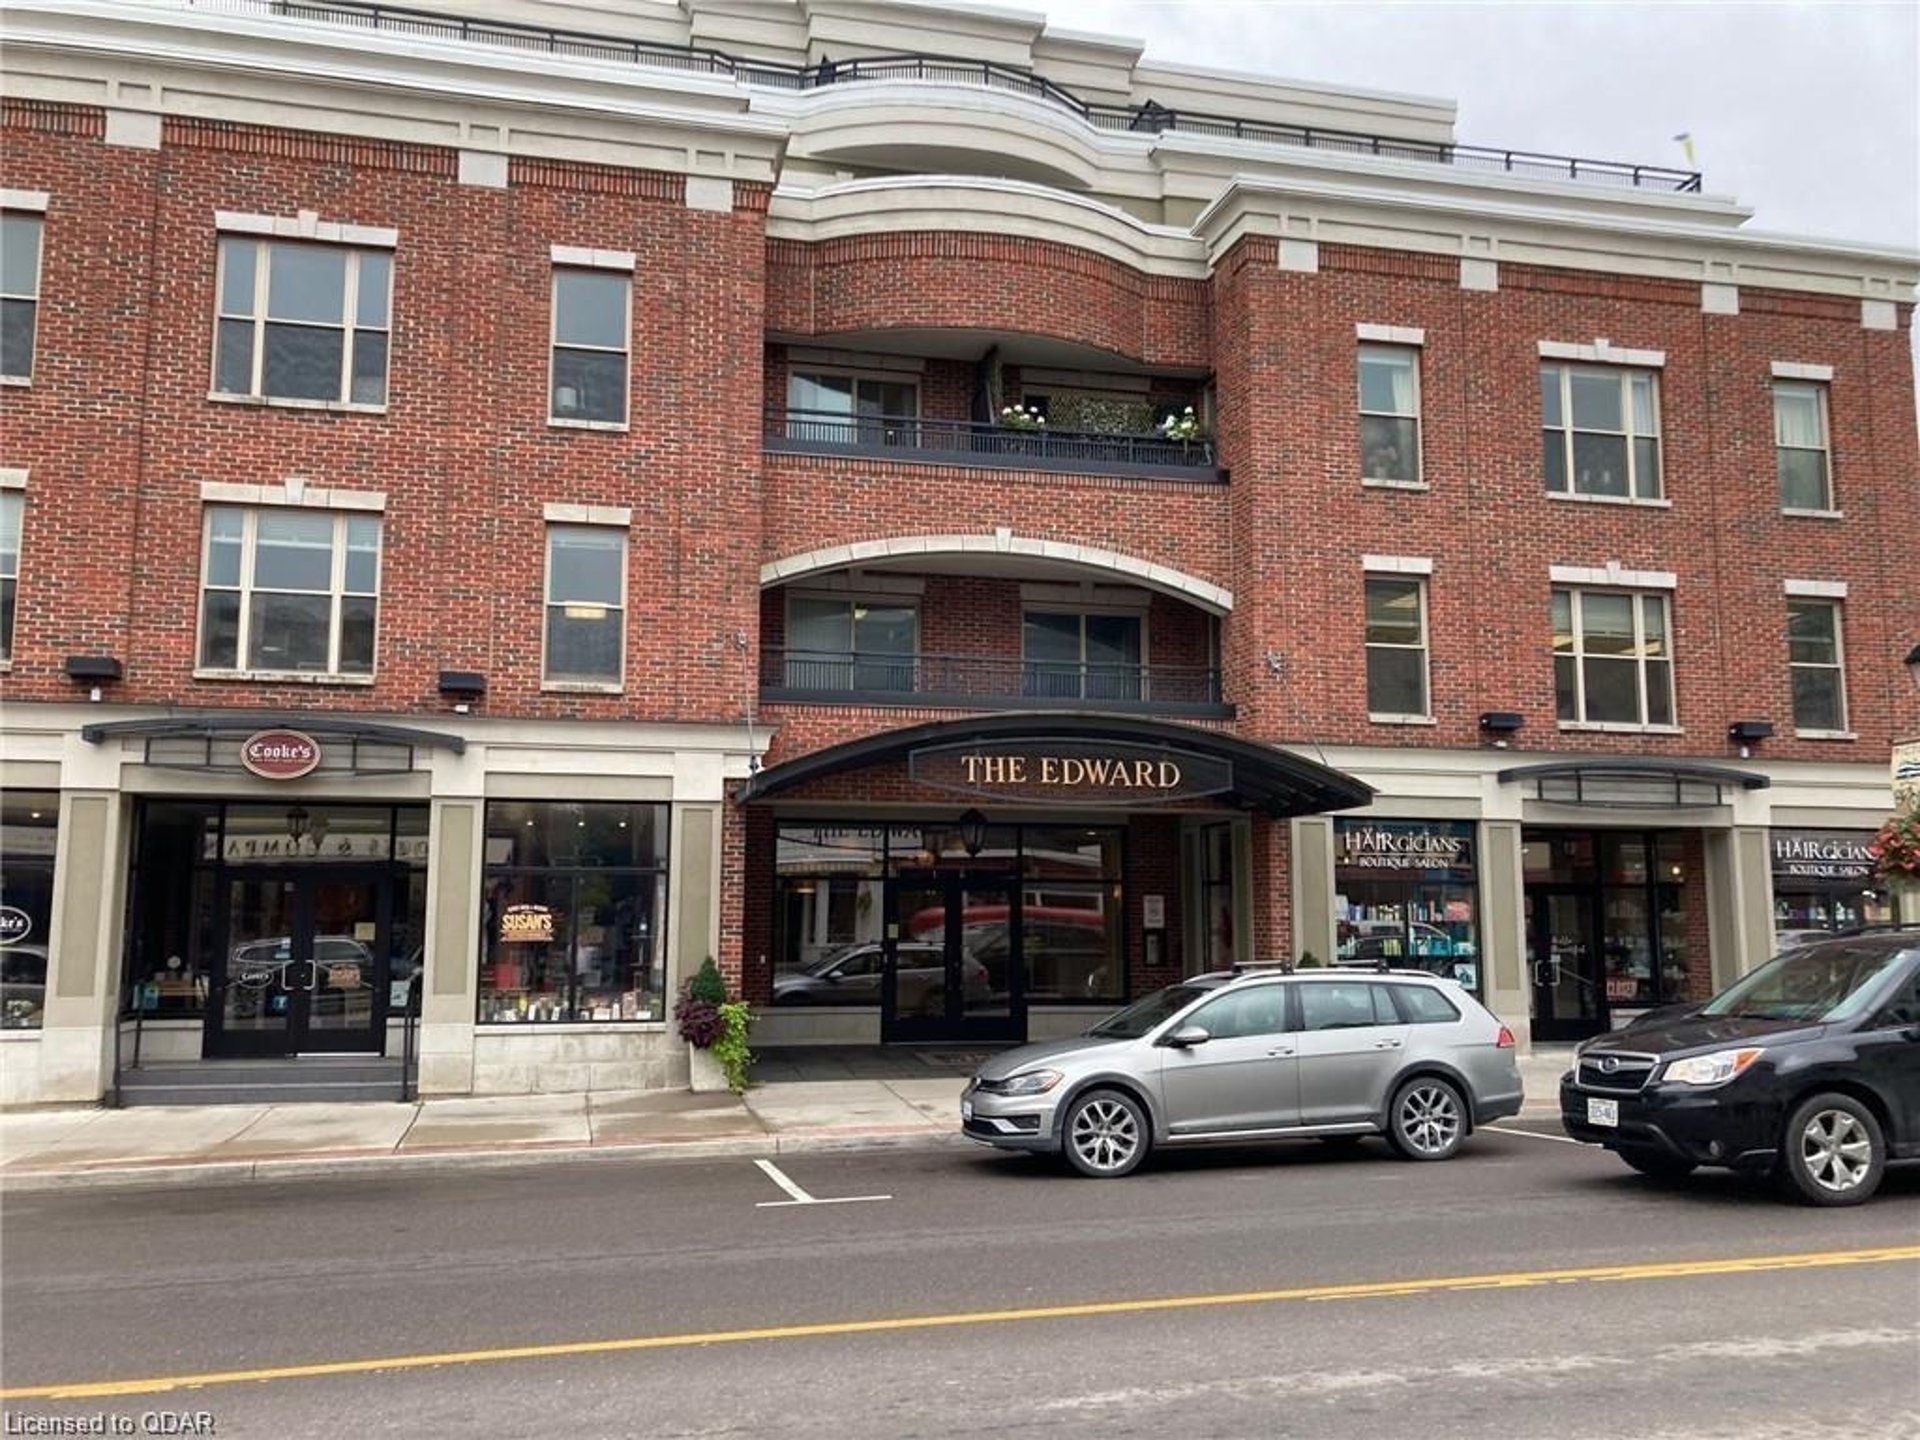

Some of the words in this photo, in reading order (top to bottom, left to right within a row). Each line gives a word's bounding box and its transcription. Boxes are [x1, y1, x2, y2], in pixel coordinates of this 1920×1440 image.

[249, 742, 312, 758] Cooke's
[961, 755, 1027, 783] THE
[1040, 757, 1181, 788] EDWARD
[1359, 857, 1409, 870] BOUTIQUE
[1415, 858, 1449, 868] SALON
[1789, 865, 1835, 877] BOUTIQUE
[1840, 865, 1869, 876] SALON
[502, 914, 552, 930] SUSAN'S
